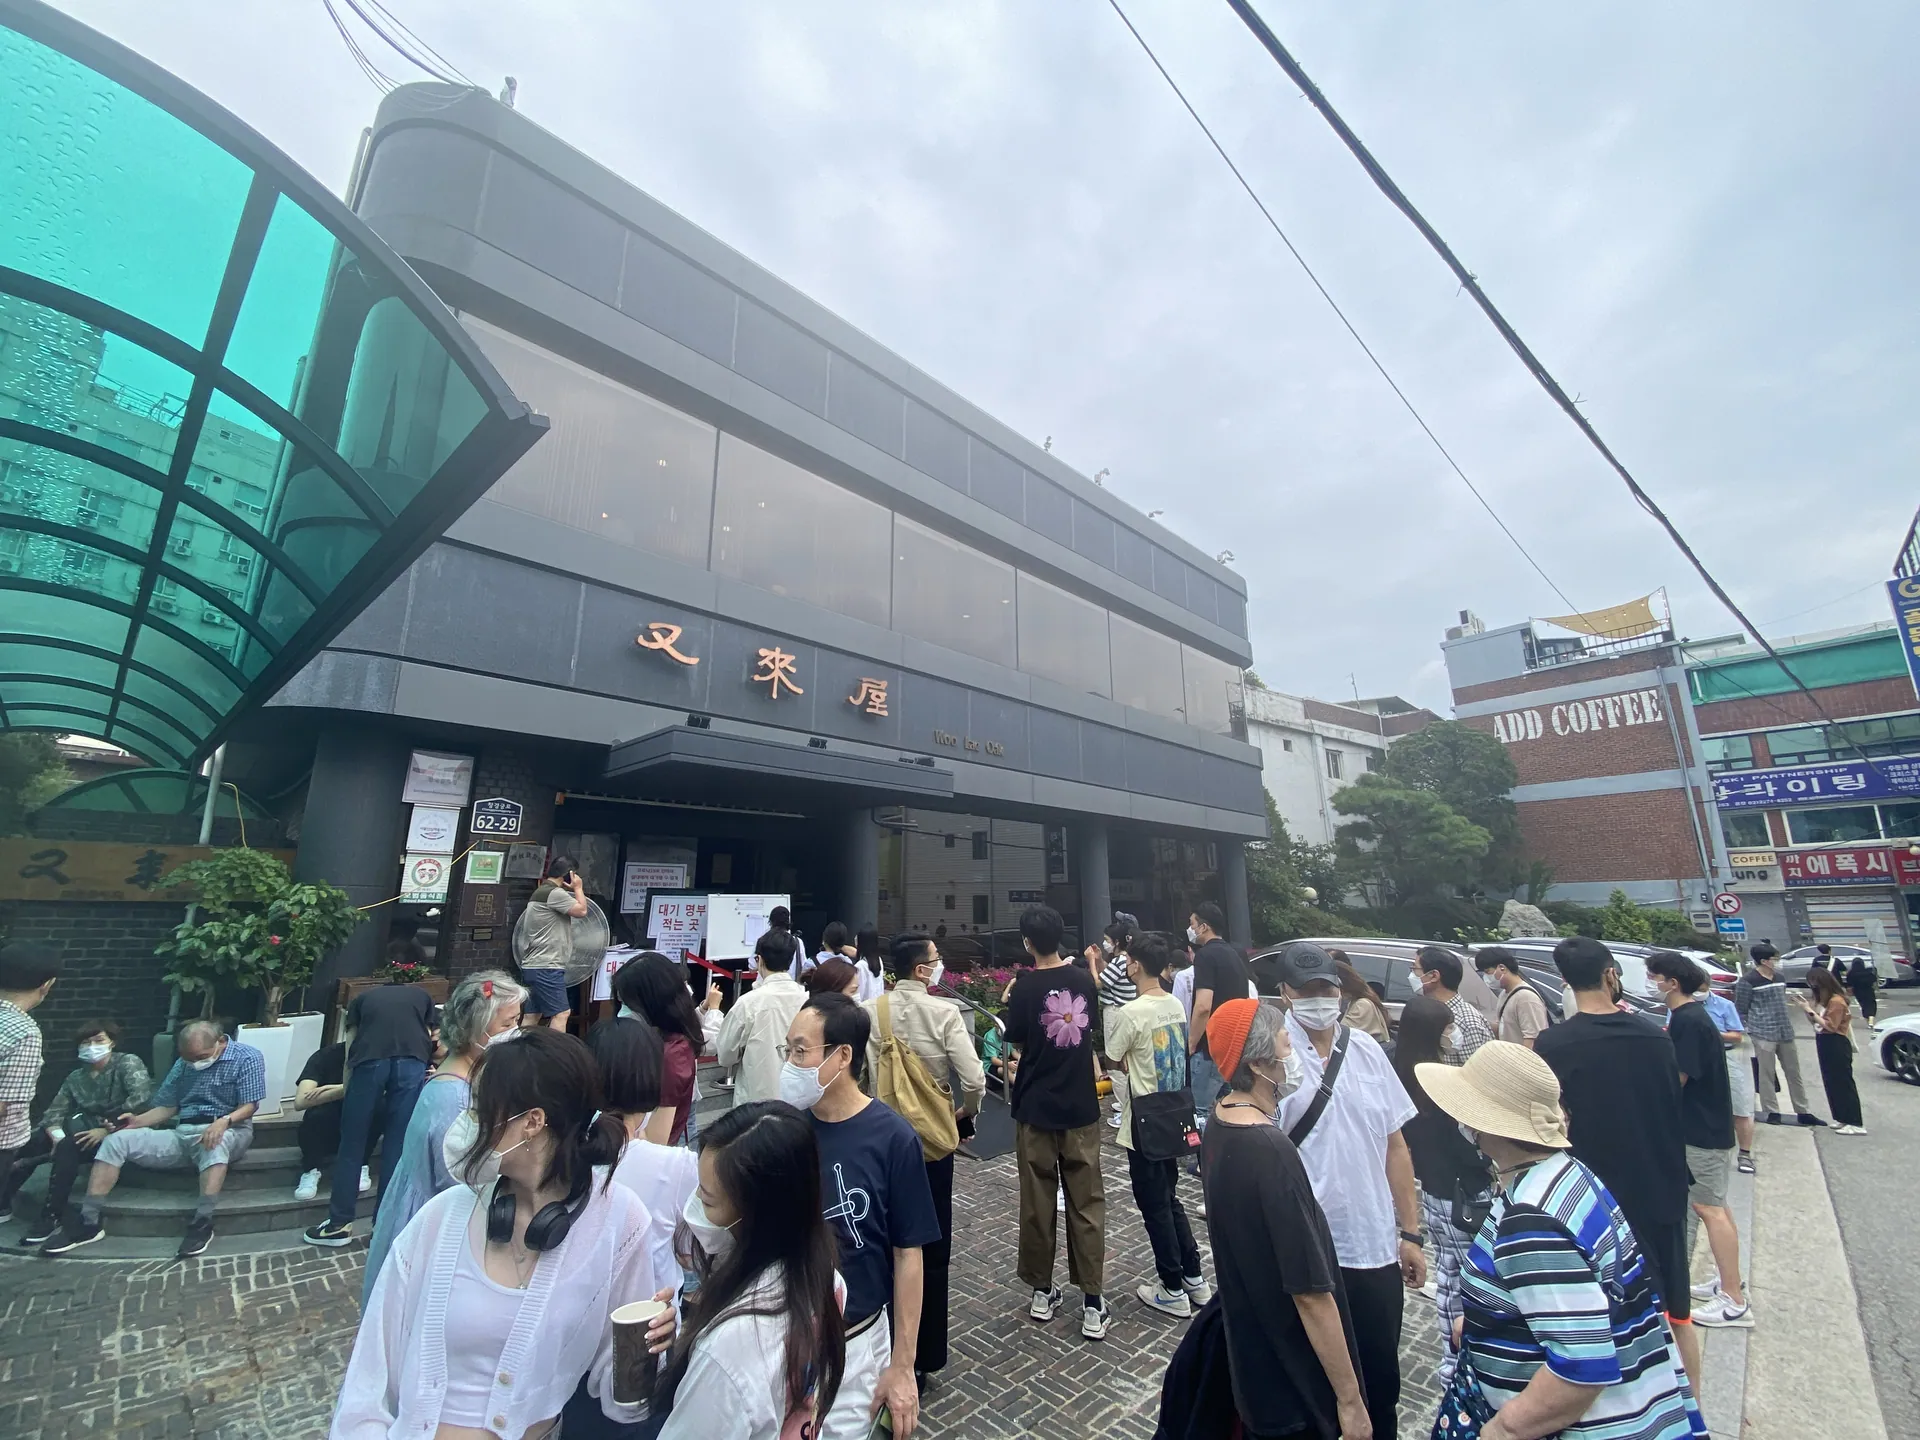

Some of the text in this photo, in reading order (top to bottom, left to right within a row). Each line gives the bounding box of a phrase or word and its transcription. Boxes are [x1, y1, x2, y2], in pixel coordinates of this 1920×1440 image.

[1494, 689, 1663, 744] ADD COFFEE
[1752, 767, 1848, 781] PARTNERSHIP
[476, 815, 517, 831] 62-29
[1732, 855, 1774, 864] COFFEE
[1806, 851, 1889, 875] 에폭시
[659, 904, 706, 917] 대기 명부
[663, 918, 699, 931] 적는 곳
